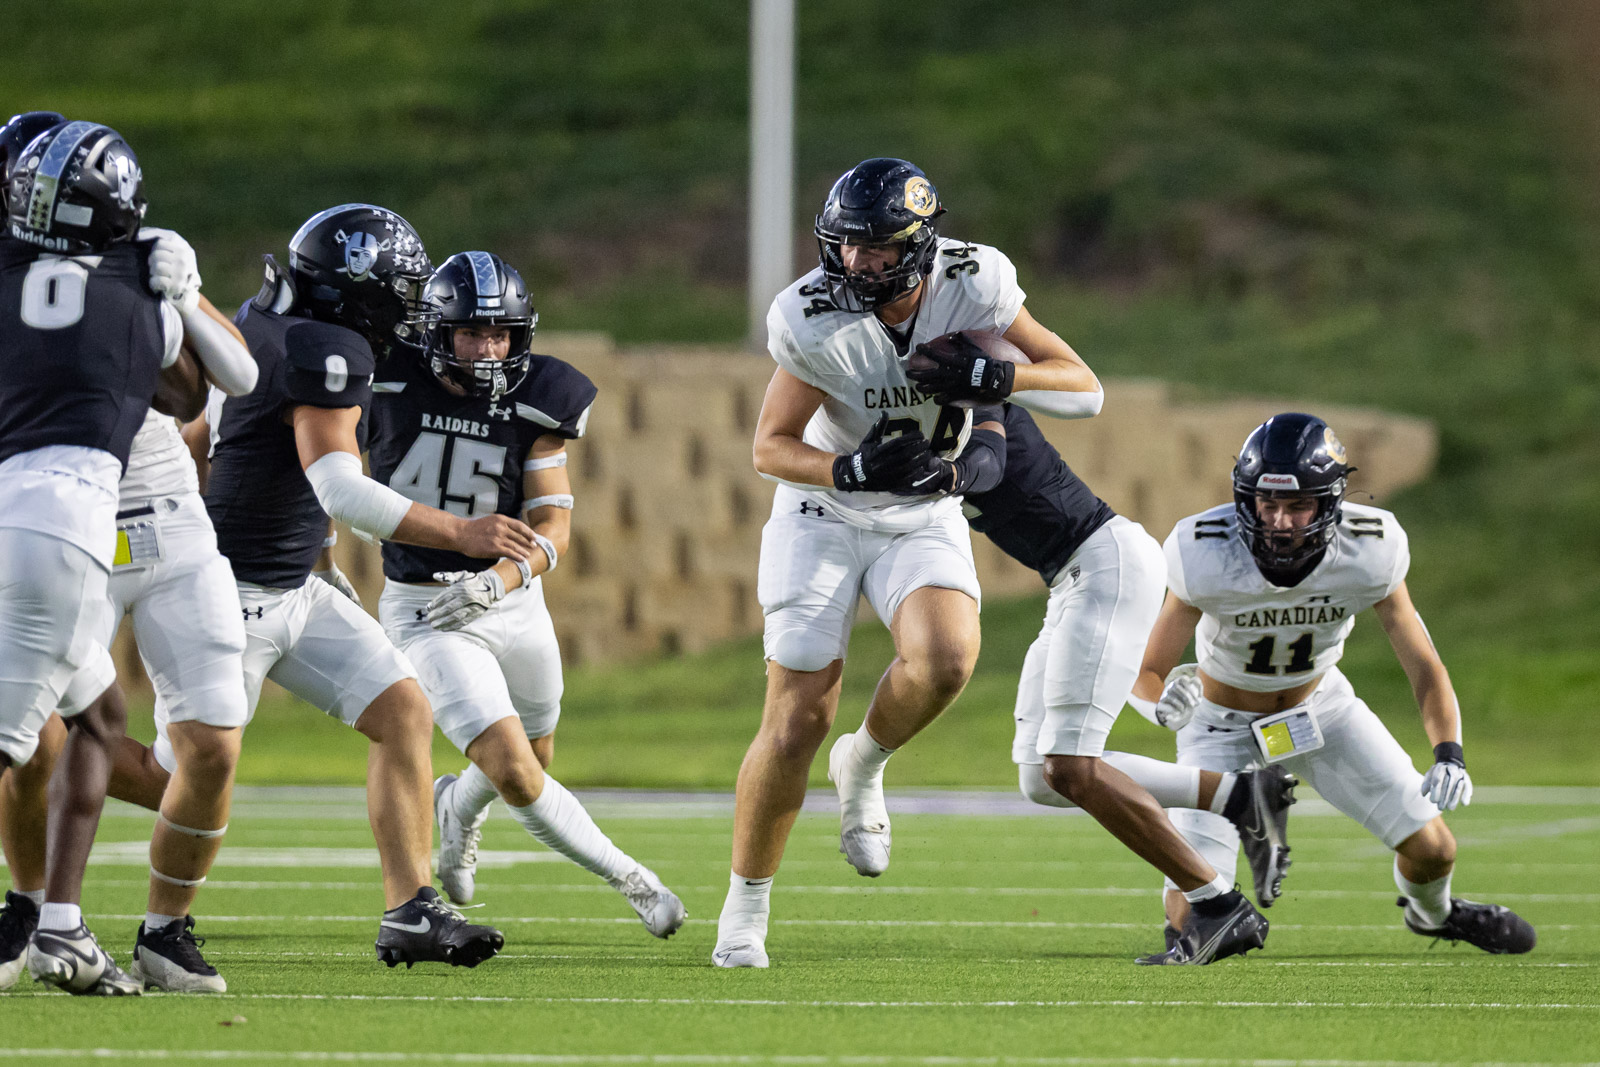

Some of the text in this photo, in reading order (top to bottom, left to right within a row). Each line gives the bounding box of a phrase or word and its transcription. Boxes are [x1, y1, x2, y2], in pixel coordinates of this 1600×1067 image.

[11, 223, 69, 251] Riddell
[942, 246, 981, 281] 34
[20, 257, 89, 331] 0
[324, 354, 349, 392] 0
[970, 358, 986, 387] NXTRND
[421, 413, 490, 437] RAIDERS
[389, 431, 507, 519] 45
[1194, 517, 1230, 540] 11
[1349, 517, 1384, 539] 11
[1235, 606, 1345, 628] CANADIAN
[1244, 632, 1316, 676] 11
